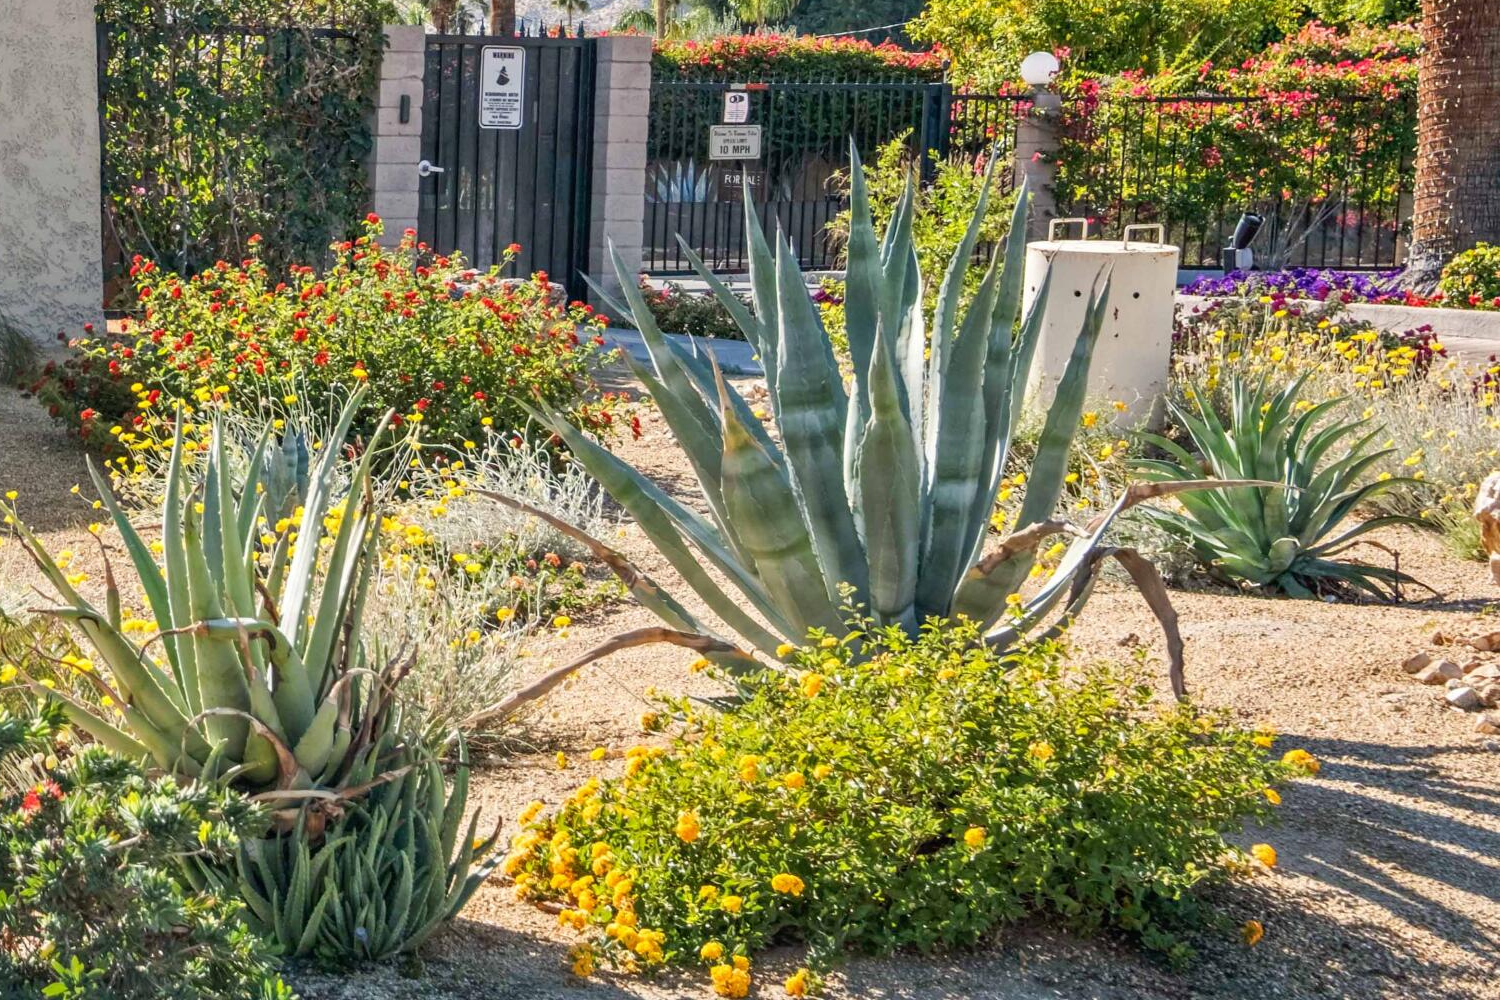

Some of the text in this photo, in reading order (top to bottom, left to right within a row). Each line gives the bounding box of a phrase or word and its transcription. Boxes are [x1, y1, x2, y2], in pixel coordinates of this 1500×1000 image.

[720, 145, 750, 154] 10 MPH
[724, 174, 740, 184] FOR
